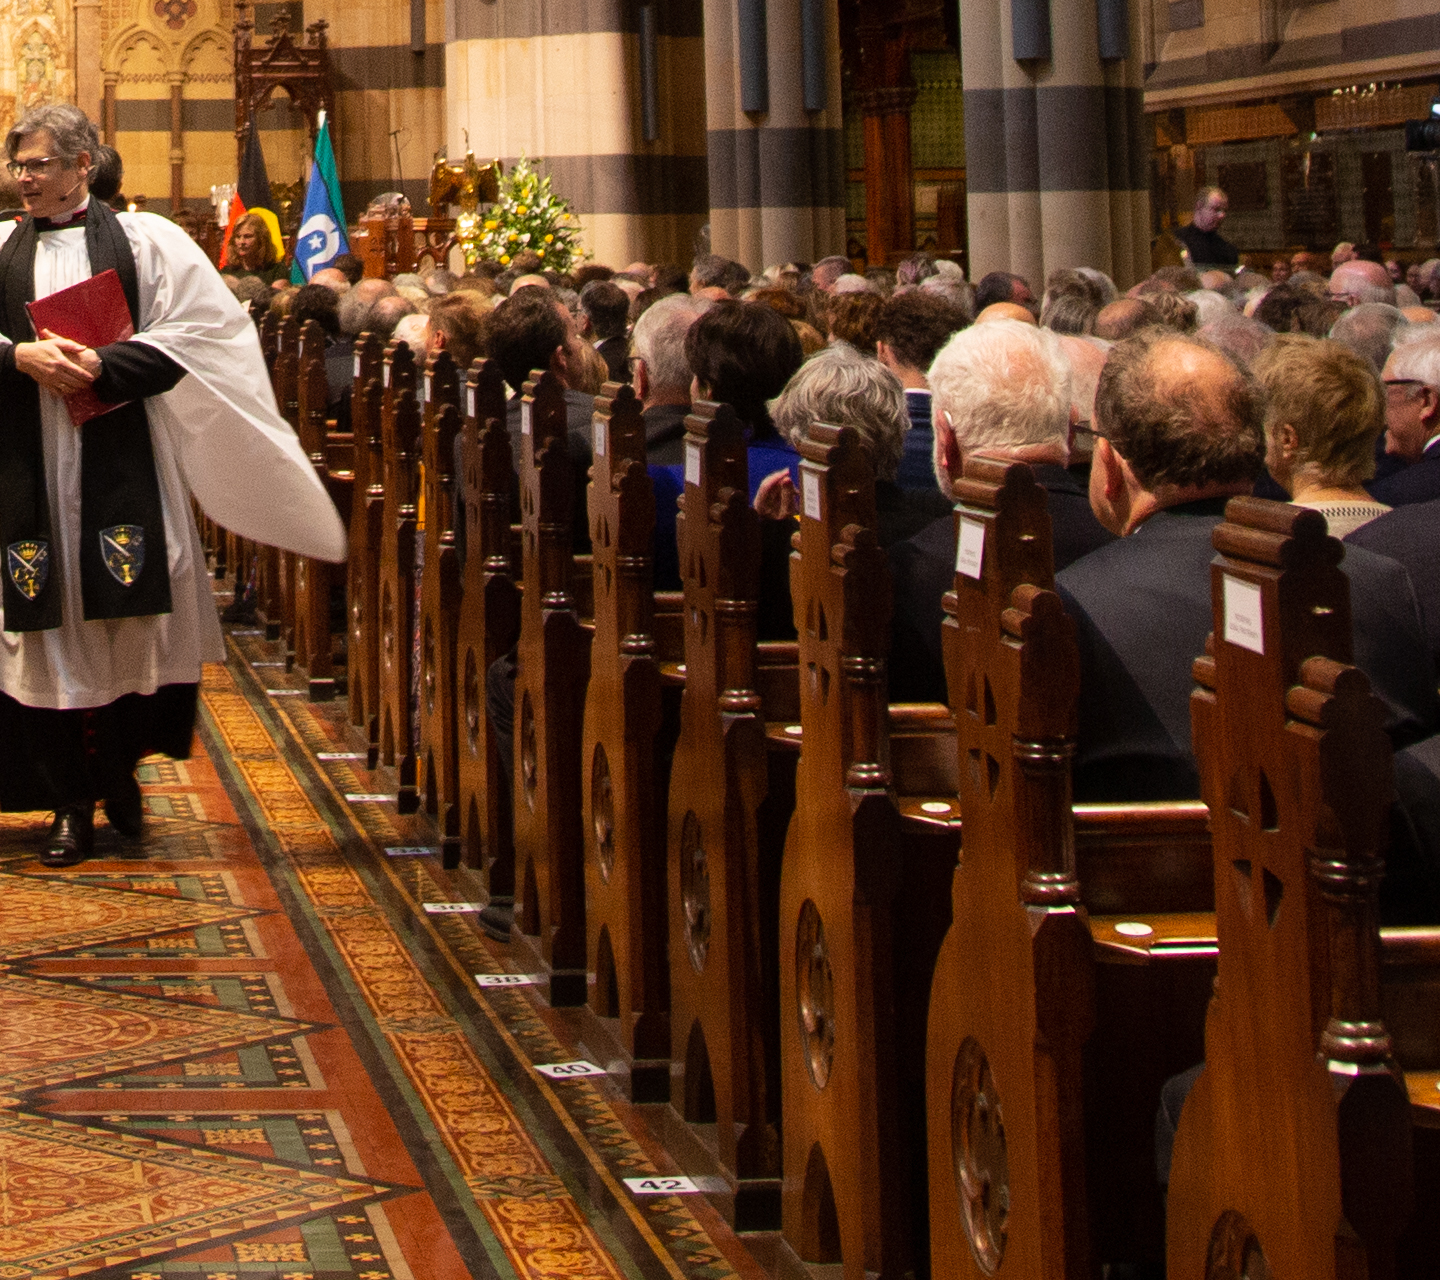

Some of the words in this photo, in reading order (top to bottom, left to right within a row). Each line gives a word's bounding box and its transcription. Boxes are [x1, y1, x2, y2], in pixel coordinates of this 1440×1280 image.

[485, 975, 522, 984] 38
[552, 1064, 592, 1075] 40
[639, 1179, 688, 1190] 42
